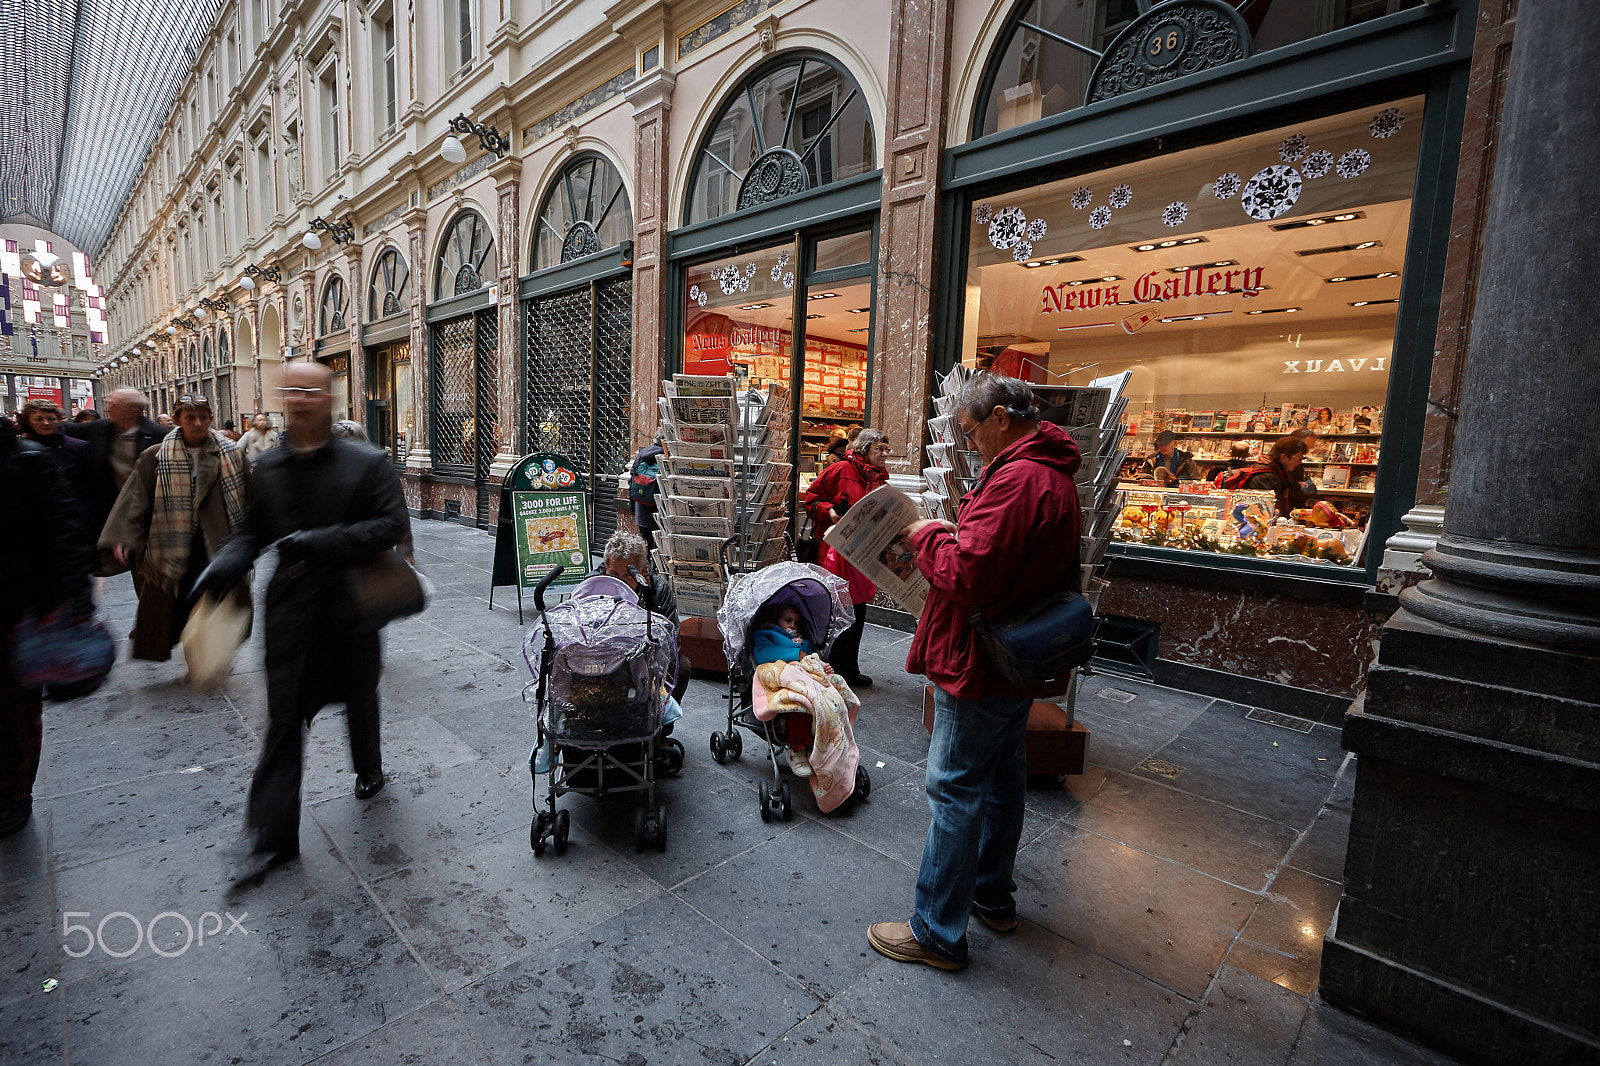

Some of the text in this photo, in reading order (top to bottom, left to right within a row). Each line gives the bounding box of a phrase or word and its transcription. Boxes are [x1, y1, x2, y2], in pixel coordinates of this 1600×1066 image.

[1150, 31, 1178, 56] 36
[1040, 265, 1265, 315] News Gallery
[691, 326, 781, 352] News Gallery
[521, 495, 578, 510] 3000 FOR LIFE
